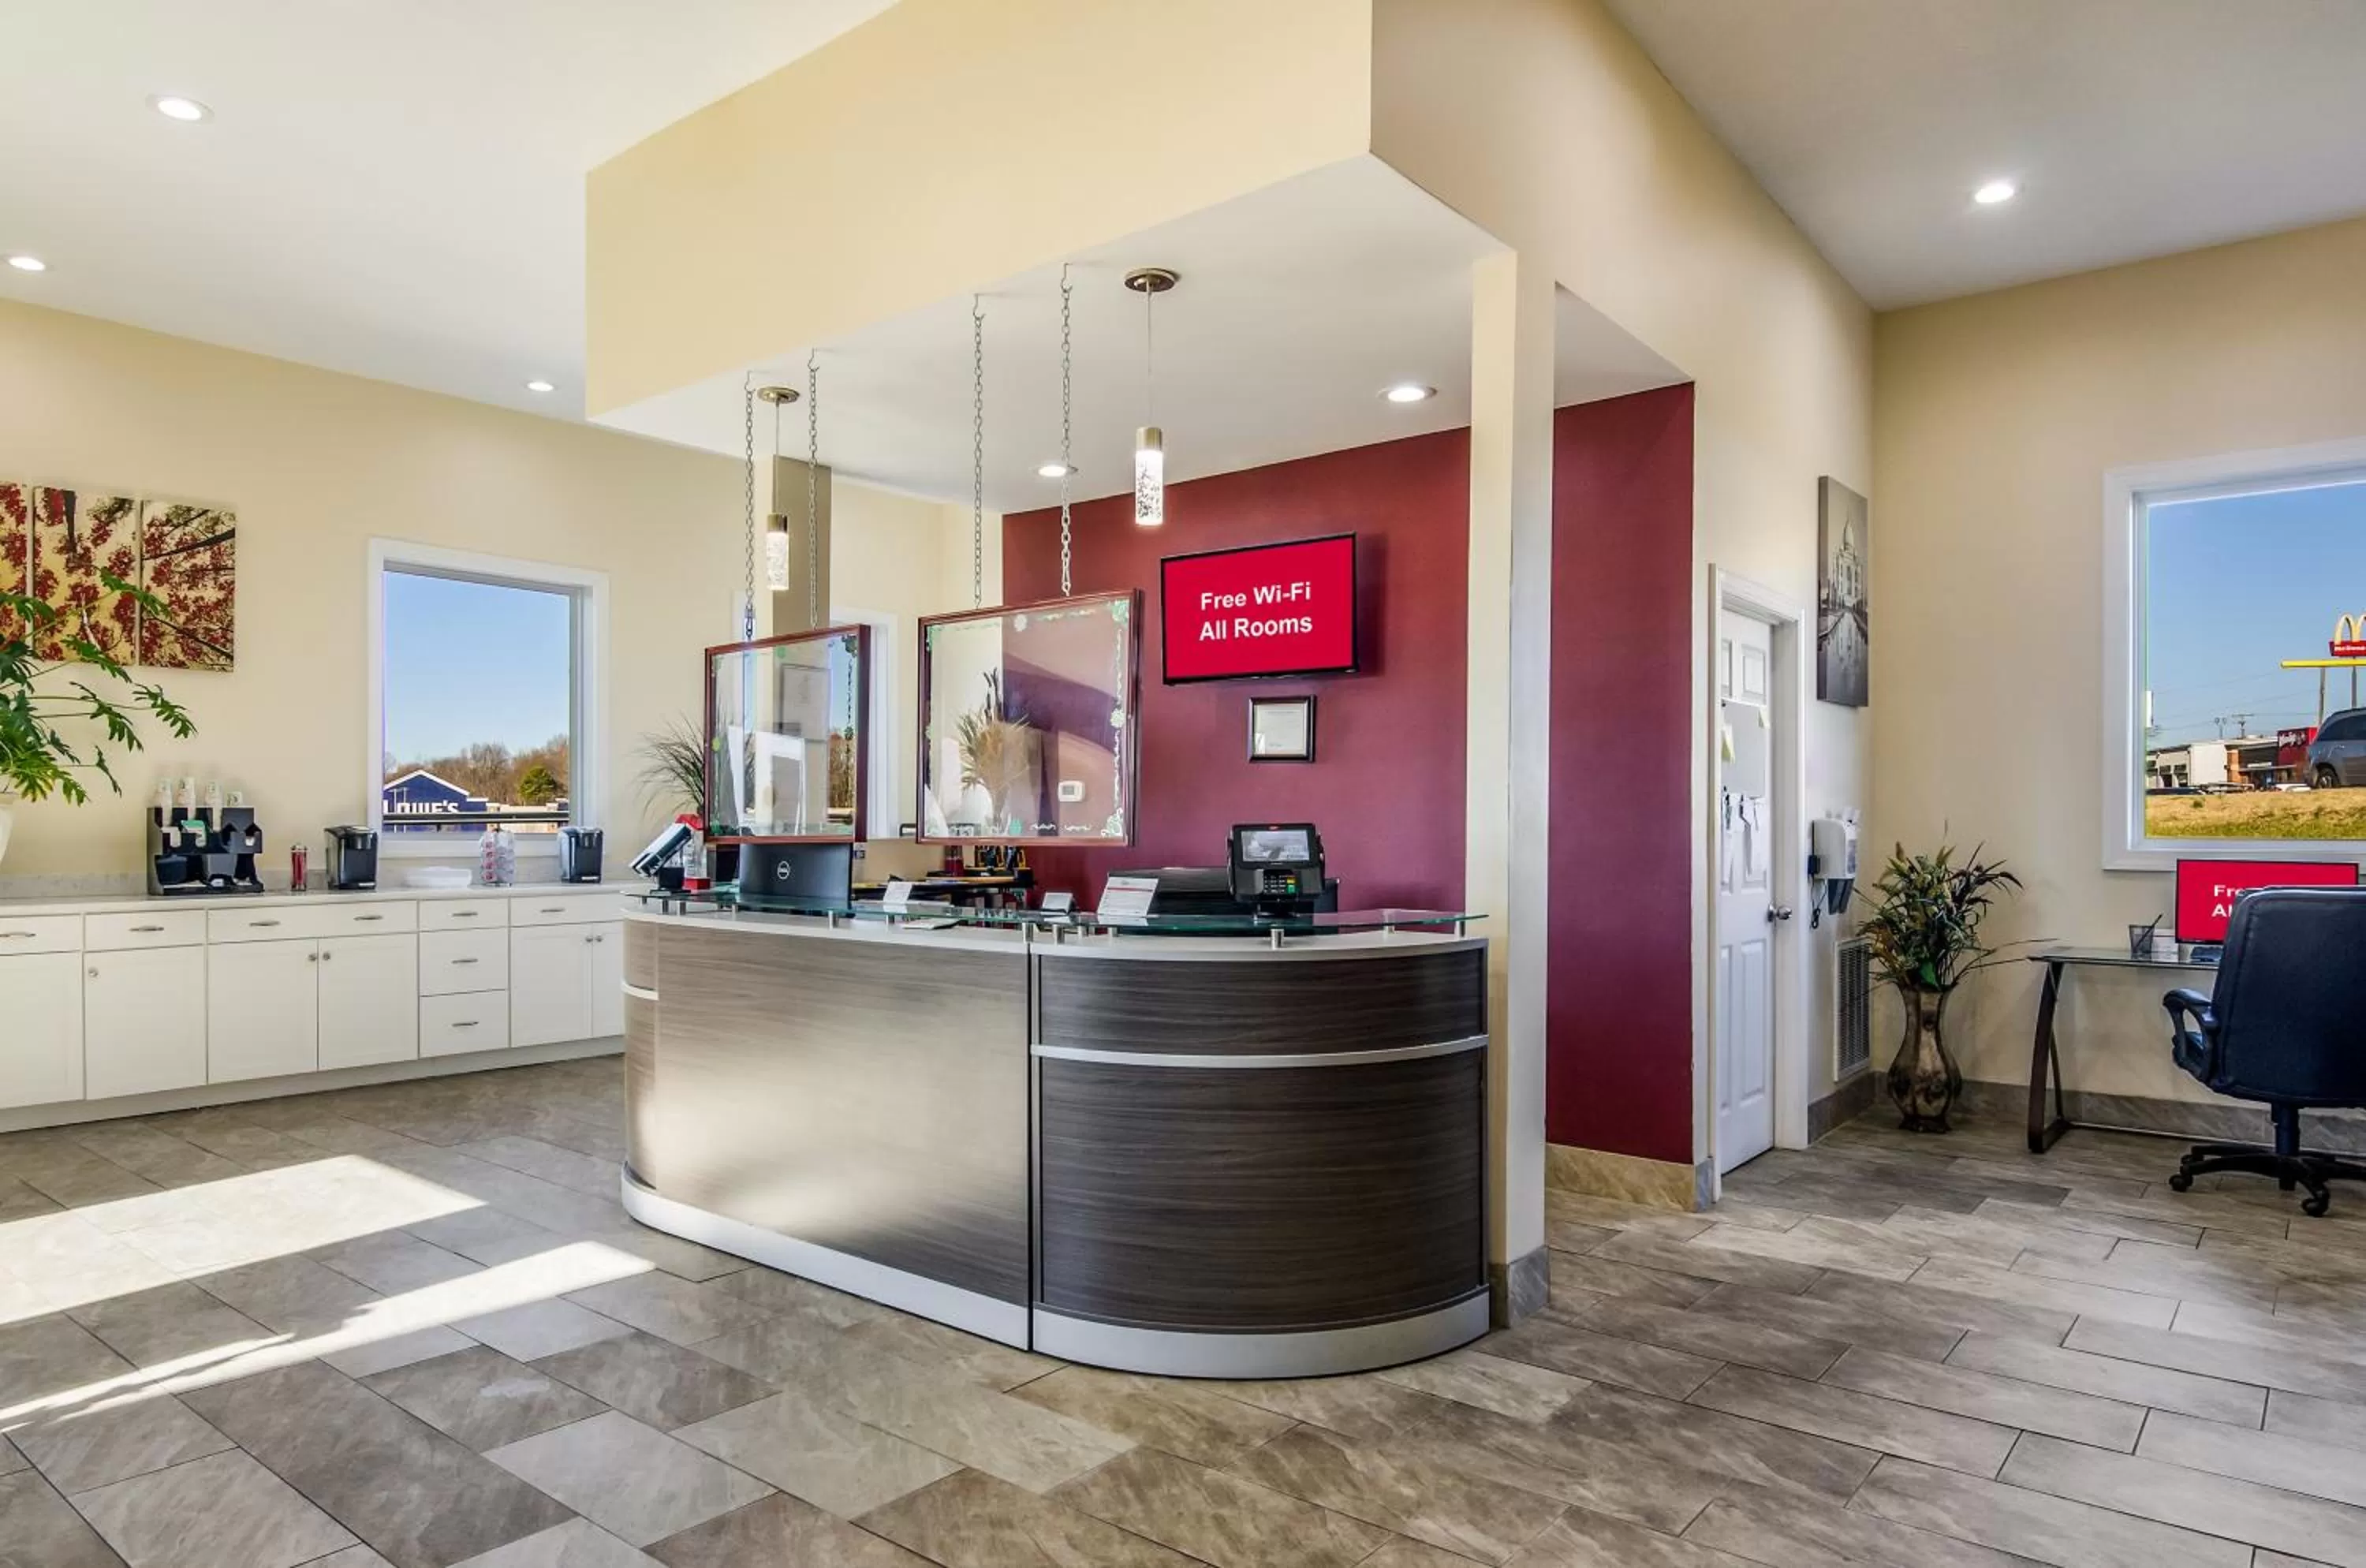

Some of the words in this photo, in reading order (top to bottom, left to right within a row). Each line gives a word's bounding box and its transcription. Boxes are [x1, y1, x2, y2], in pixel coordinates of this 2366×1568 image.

[1200, 592, 1247, 611] Free
[1253, 581, 1312, 605] Wi-Fi
[1199, 618, 1227, 640] All
[1234, 616, 1313, 637] Rooms
[2211, 903, 2233, 917] Al
